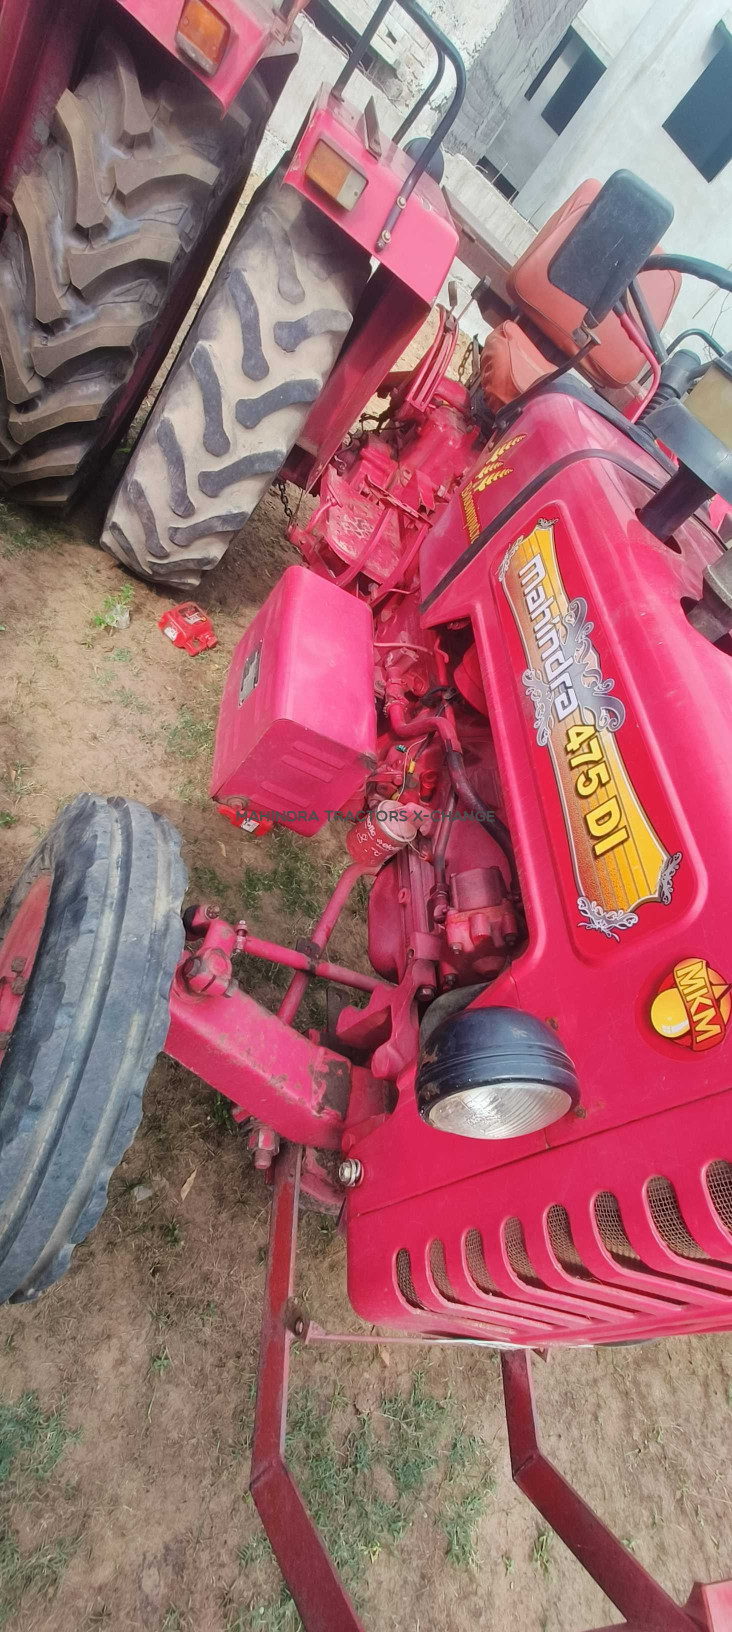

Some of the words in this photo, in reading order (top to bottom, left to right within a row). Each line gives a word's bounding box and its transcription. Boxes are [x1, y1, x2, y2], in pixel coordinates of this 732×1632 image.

[566, 724, 612, 797] 475
[586, 801, 629, 856] DI
[676, 961, 722, 1043] MKM
